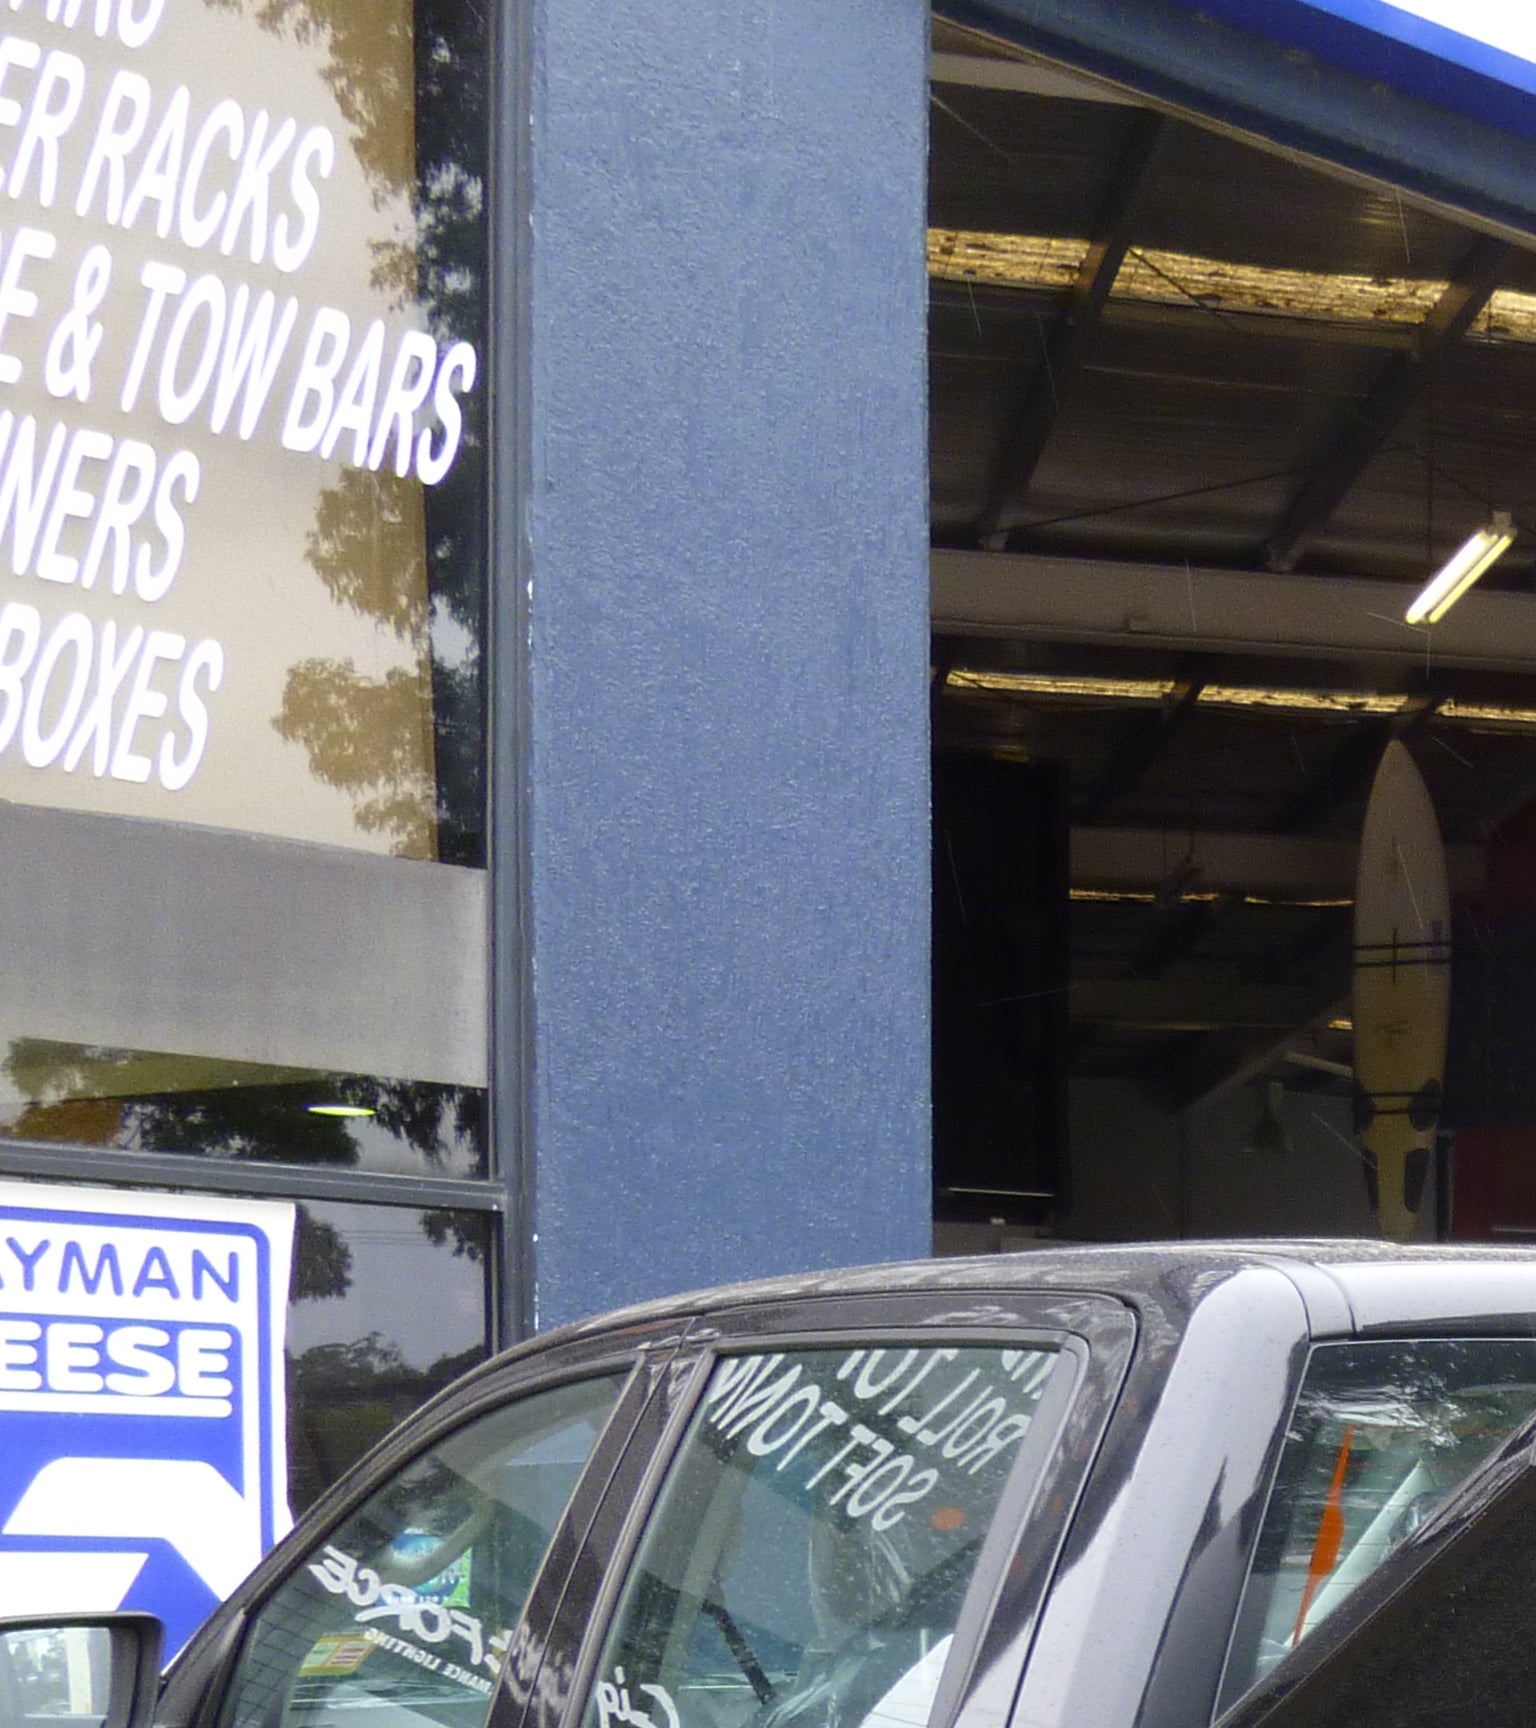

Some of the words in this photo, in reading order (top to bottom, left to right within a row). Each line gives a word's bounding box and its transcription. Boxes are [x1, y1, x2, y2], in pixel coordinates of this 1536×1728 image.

[75, 69, 335, 273] RACKS
[44, 244, 112, 402] &
[120, 261, 299, 440] TOW
[281, 306, 477, 486] BARS
[0, 409, 200, 602] NERS
[0, 601, 225, 791] BOXES
[0, 1236, 239, 1303] YMAN
